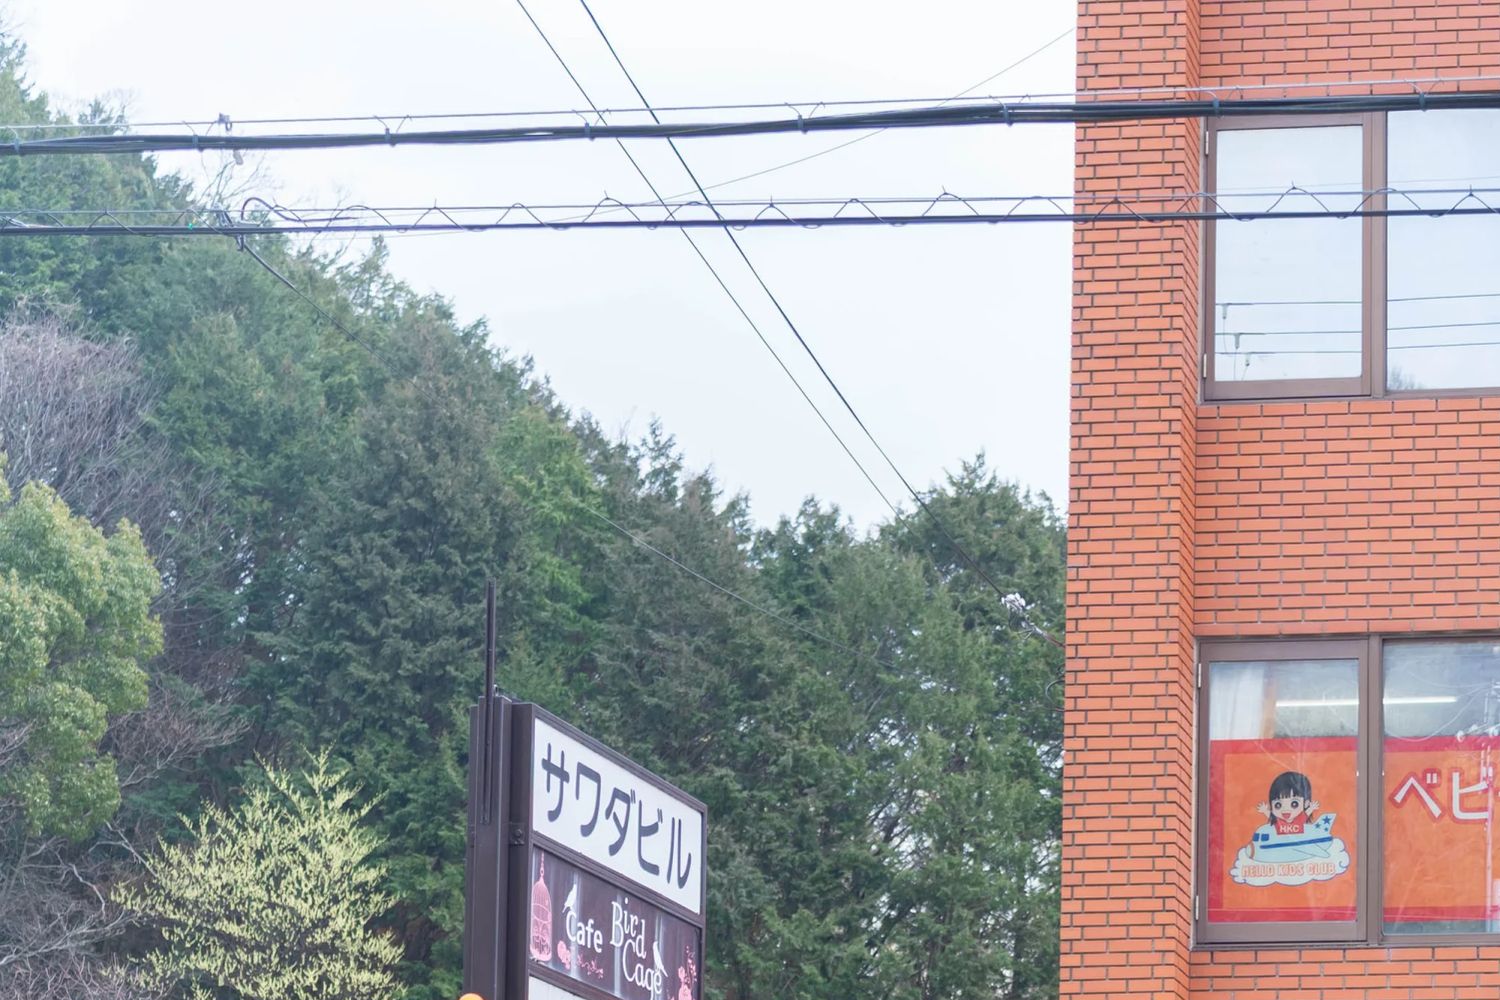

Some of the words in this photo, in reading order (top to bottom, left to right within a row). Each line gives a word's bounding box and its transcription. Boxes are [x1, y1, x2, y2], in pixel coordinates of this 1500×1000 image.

[541, 742, 693, 889] サワダビル
[1280, 824, 1300, 833] HKC
[1242, 864, 1275, 878] HELLO
[1278, 863, 1304, 876] KIDS
[1307, 862, 1336, 876] CLUB
[566, 910, 603, 953] Cafe
[610, 897, 647, 959] Bird
